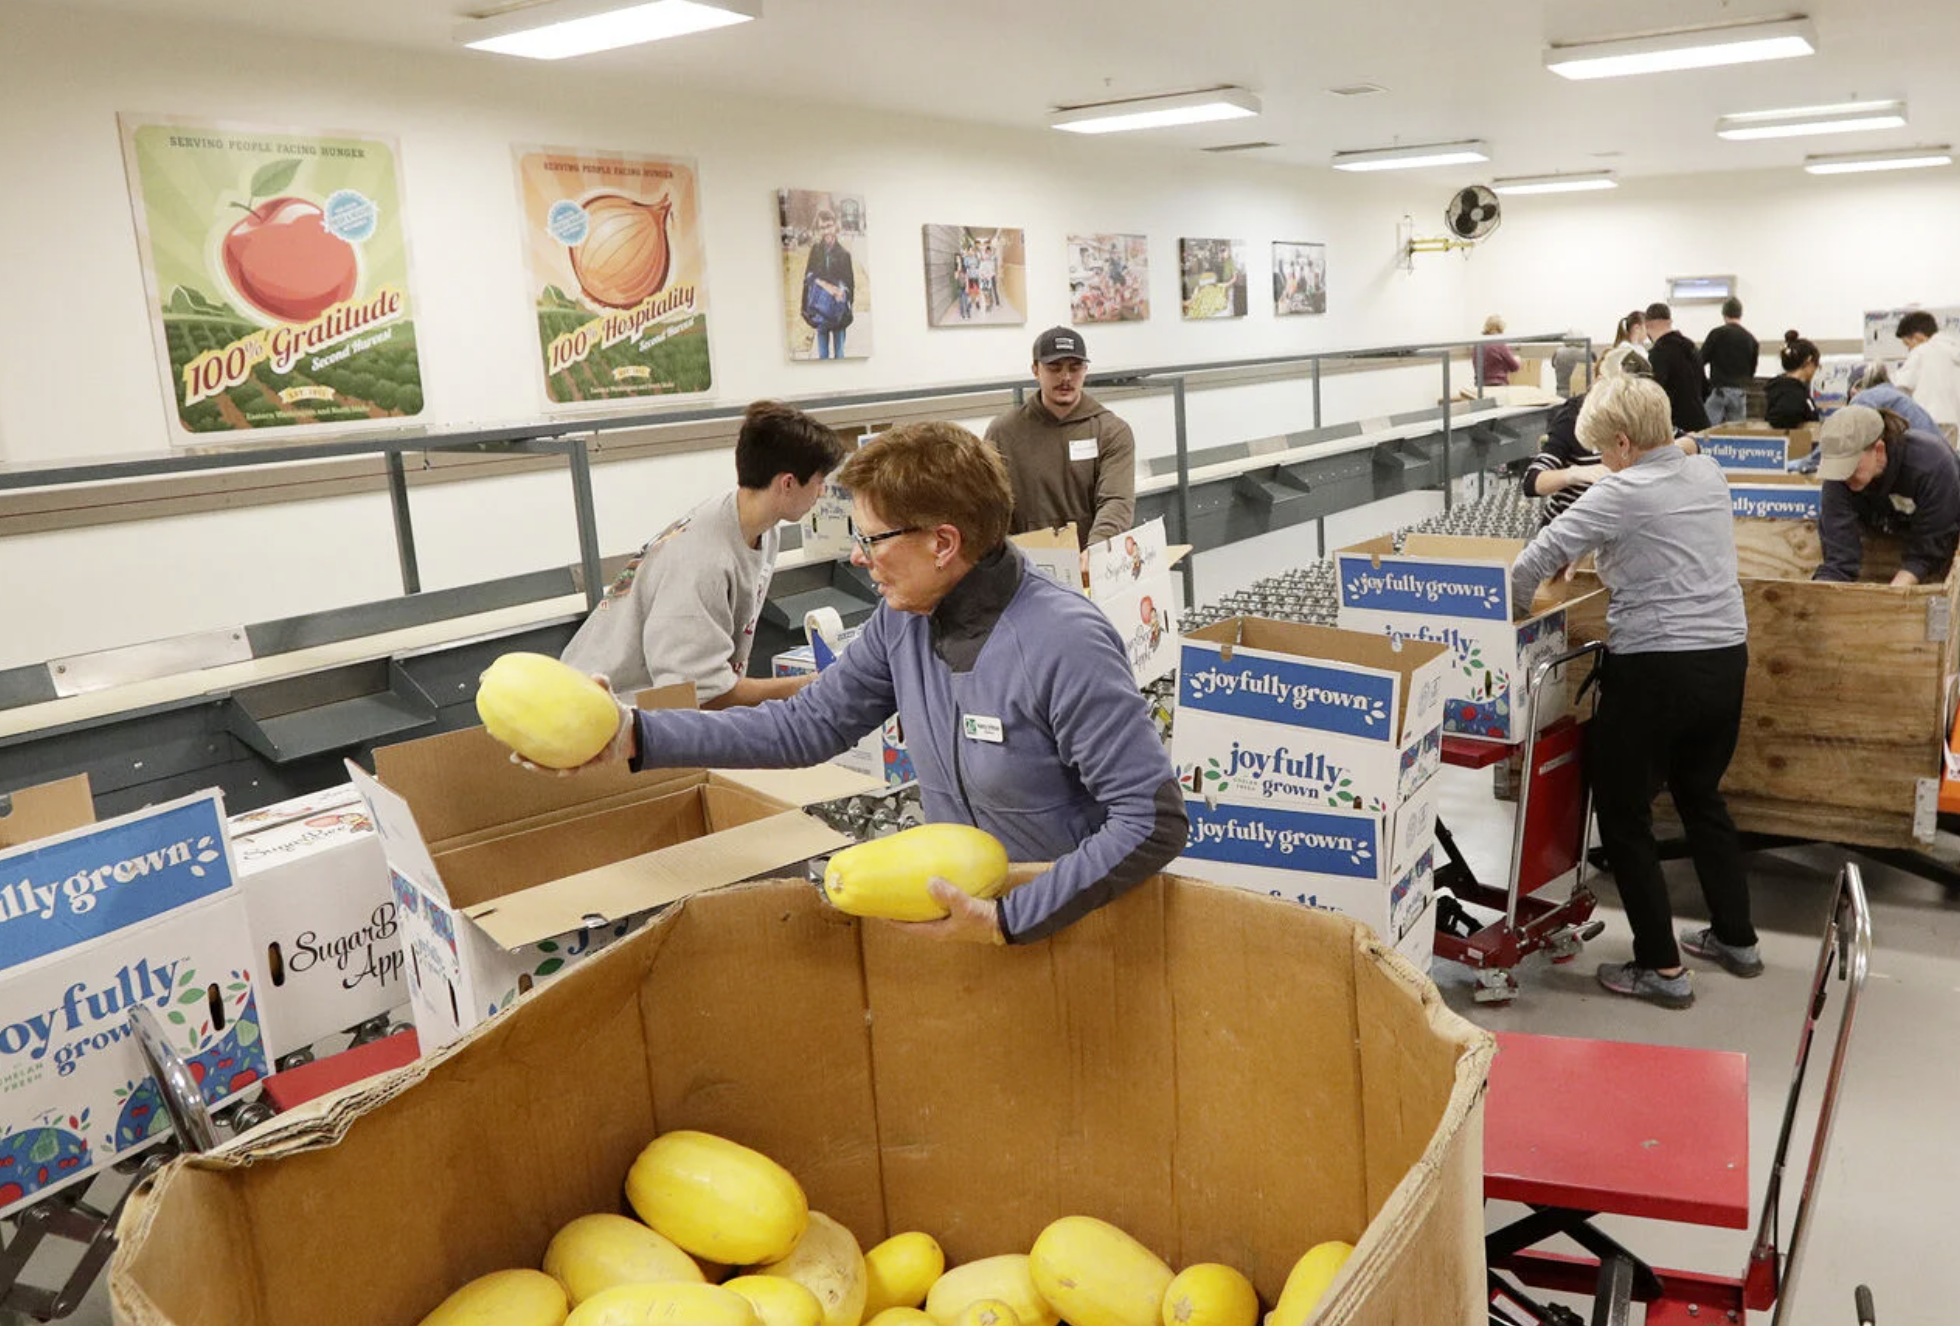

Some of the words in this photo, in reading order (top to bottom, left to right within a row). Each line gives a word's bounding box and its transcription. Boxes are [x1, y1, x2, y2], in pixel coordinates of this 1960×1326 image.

[169, 136, 223, 150] SERVING
[228, 140, 272, 153] PEOPLE
[276, 143, 317, 155] FACING
[321, 146, 366, 159] HUNGER
[190, 340, 263, 397] 100%
[271, 290, 400, 368] Gratitude
[553, 328, 598, 367] 100%
[602, 285, 694, 342] Hospitality
[311, 344, 351, 371] Second
[1224, 741, 1342, 792] joyfully
[1262, 779, 1319, 799] grown
[289, 901, 397, 972] SugarB
[342, 943, 404, 989] App
[54, 1019, 135, 1077] grow
